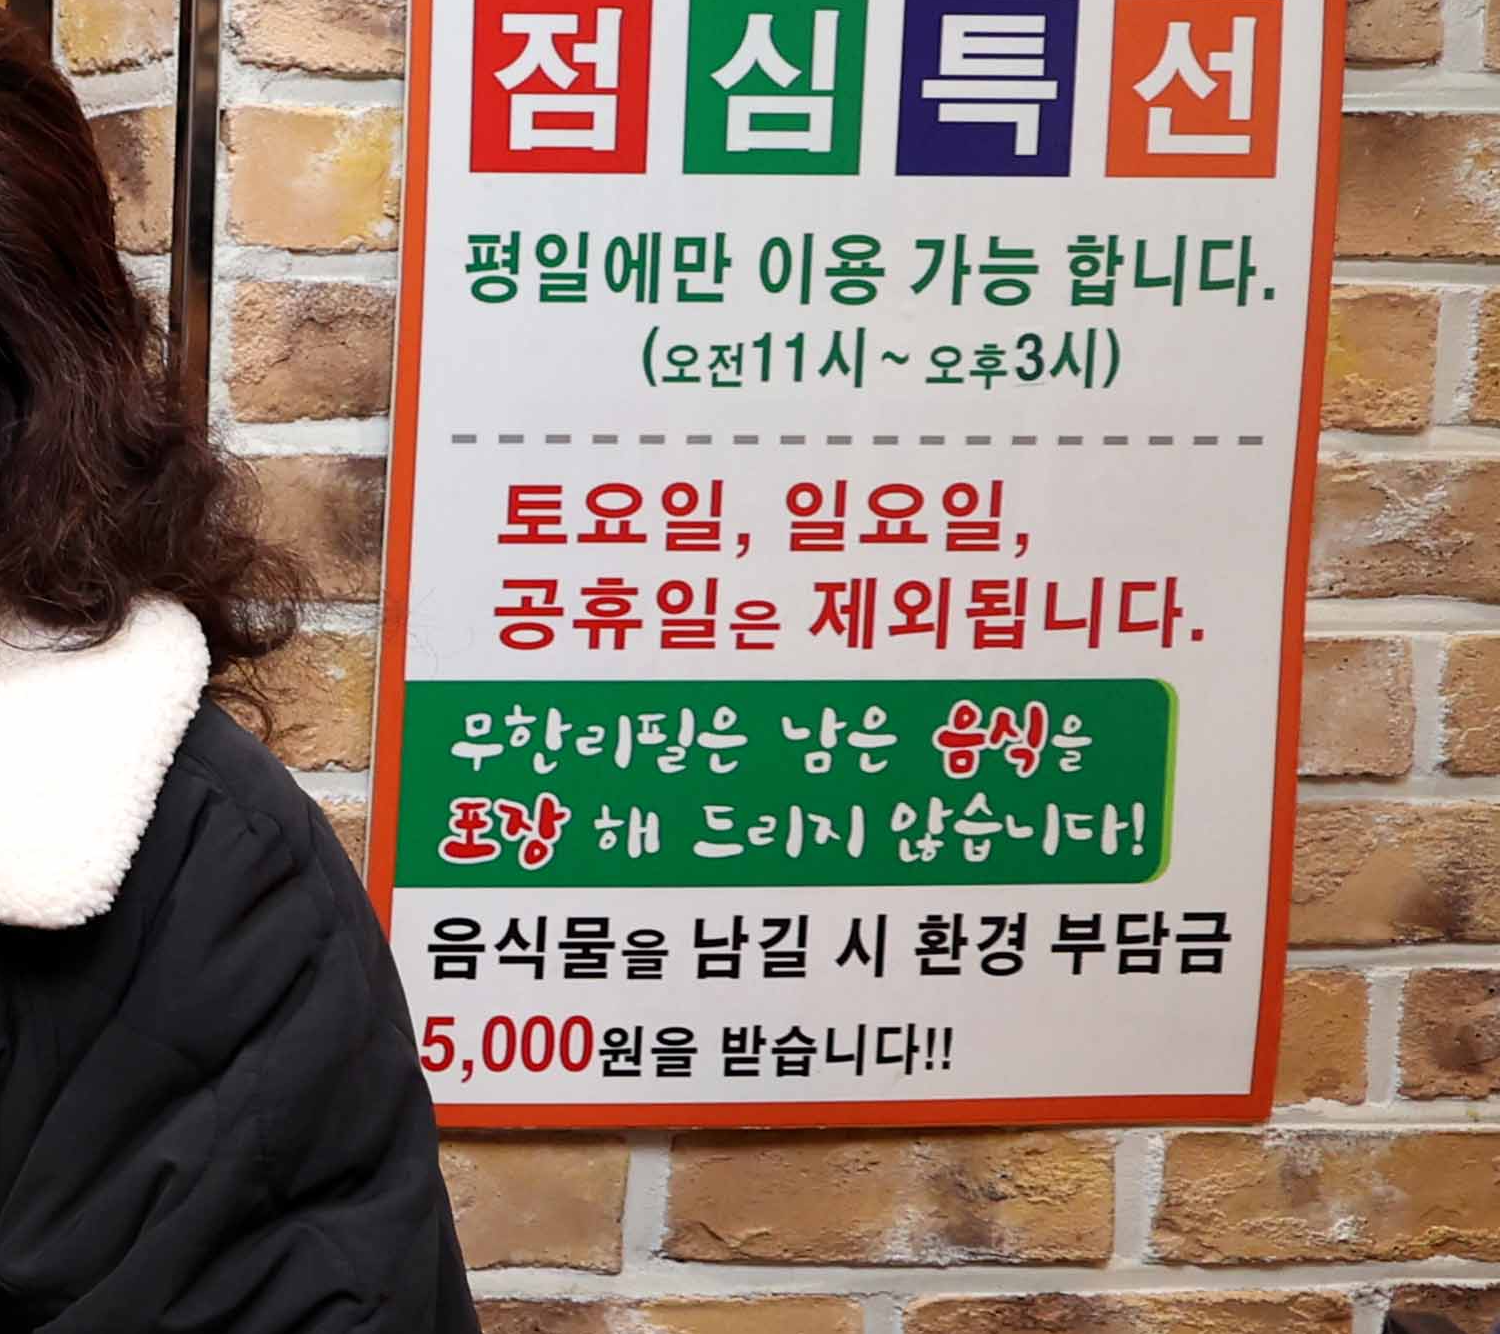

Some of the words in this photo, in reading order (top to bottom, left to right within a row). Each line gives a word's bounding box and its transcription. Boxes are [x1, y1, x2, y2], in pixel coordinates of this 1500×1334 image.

[464, 230, 732, 308] 평일에만
[758, 231, 886, 306] 이용
[909, 233, 1041, 307] 가능
[1065, 233, 1279, 308] 합니다.
[497, 480, 751, 560] 토요일,
[785, 479, 1032, 559] 일요일,
[493, 576, 783, 652] 공휴일은
[808, 575, 1206, 651] 제외됩니다.
[449, 704, 749, 774] 무한리필은
[781, 706, 898, 775] 남은
[931, 698, 1095, 779] 음식을
[436, 792, 572, 870] 포장
[593, 804, 660, 858] 해
[692, 801, 866, 860] 드리지
[890, 792, 1148, 864] 않습니다!
[426, 914, 671, 980] 음식물을
[692, 914, 810, 979] 남길
[836, 913, 888, 979] 시
[912, 911, 1029, 978] 환경
[1049, 909, 1234, 977] 부담금
[418, 1012, 700, 1085] 5,000원을
[719, 1023, 955, 1078] 받습니다!!
